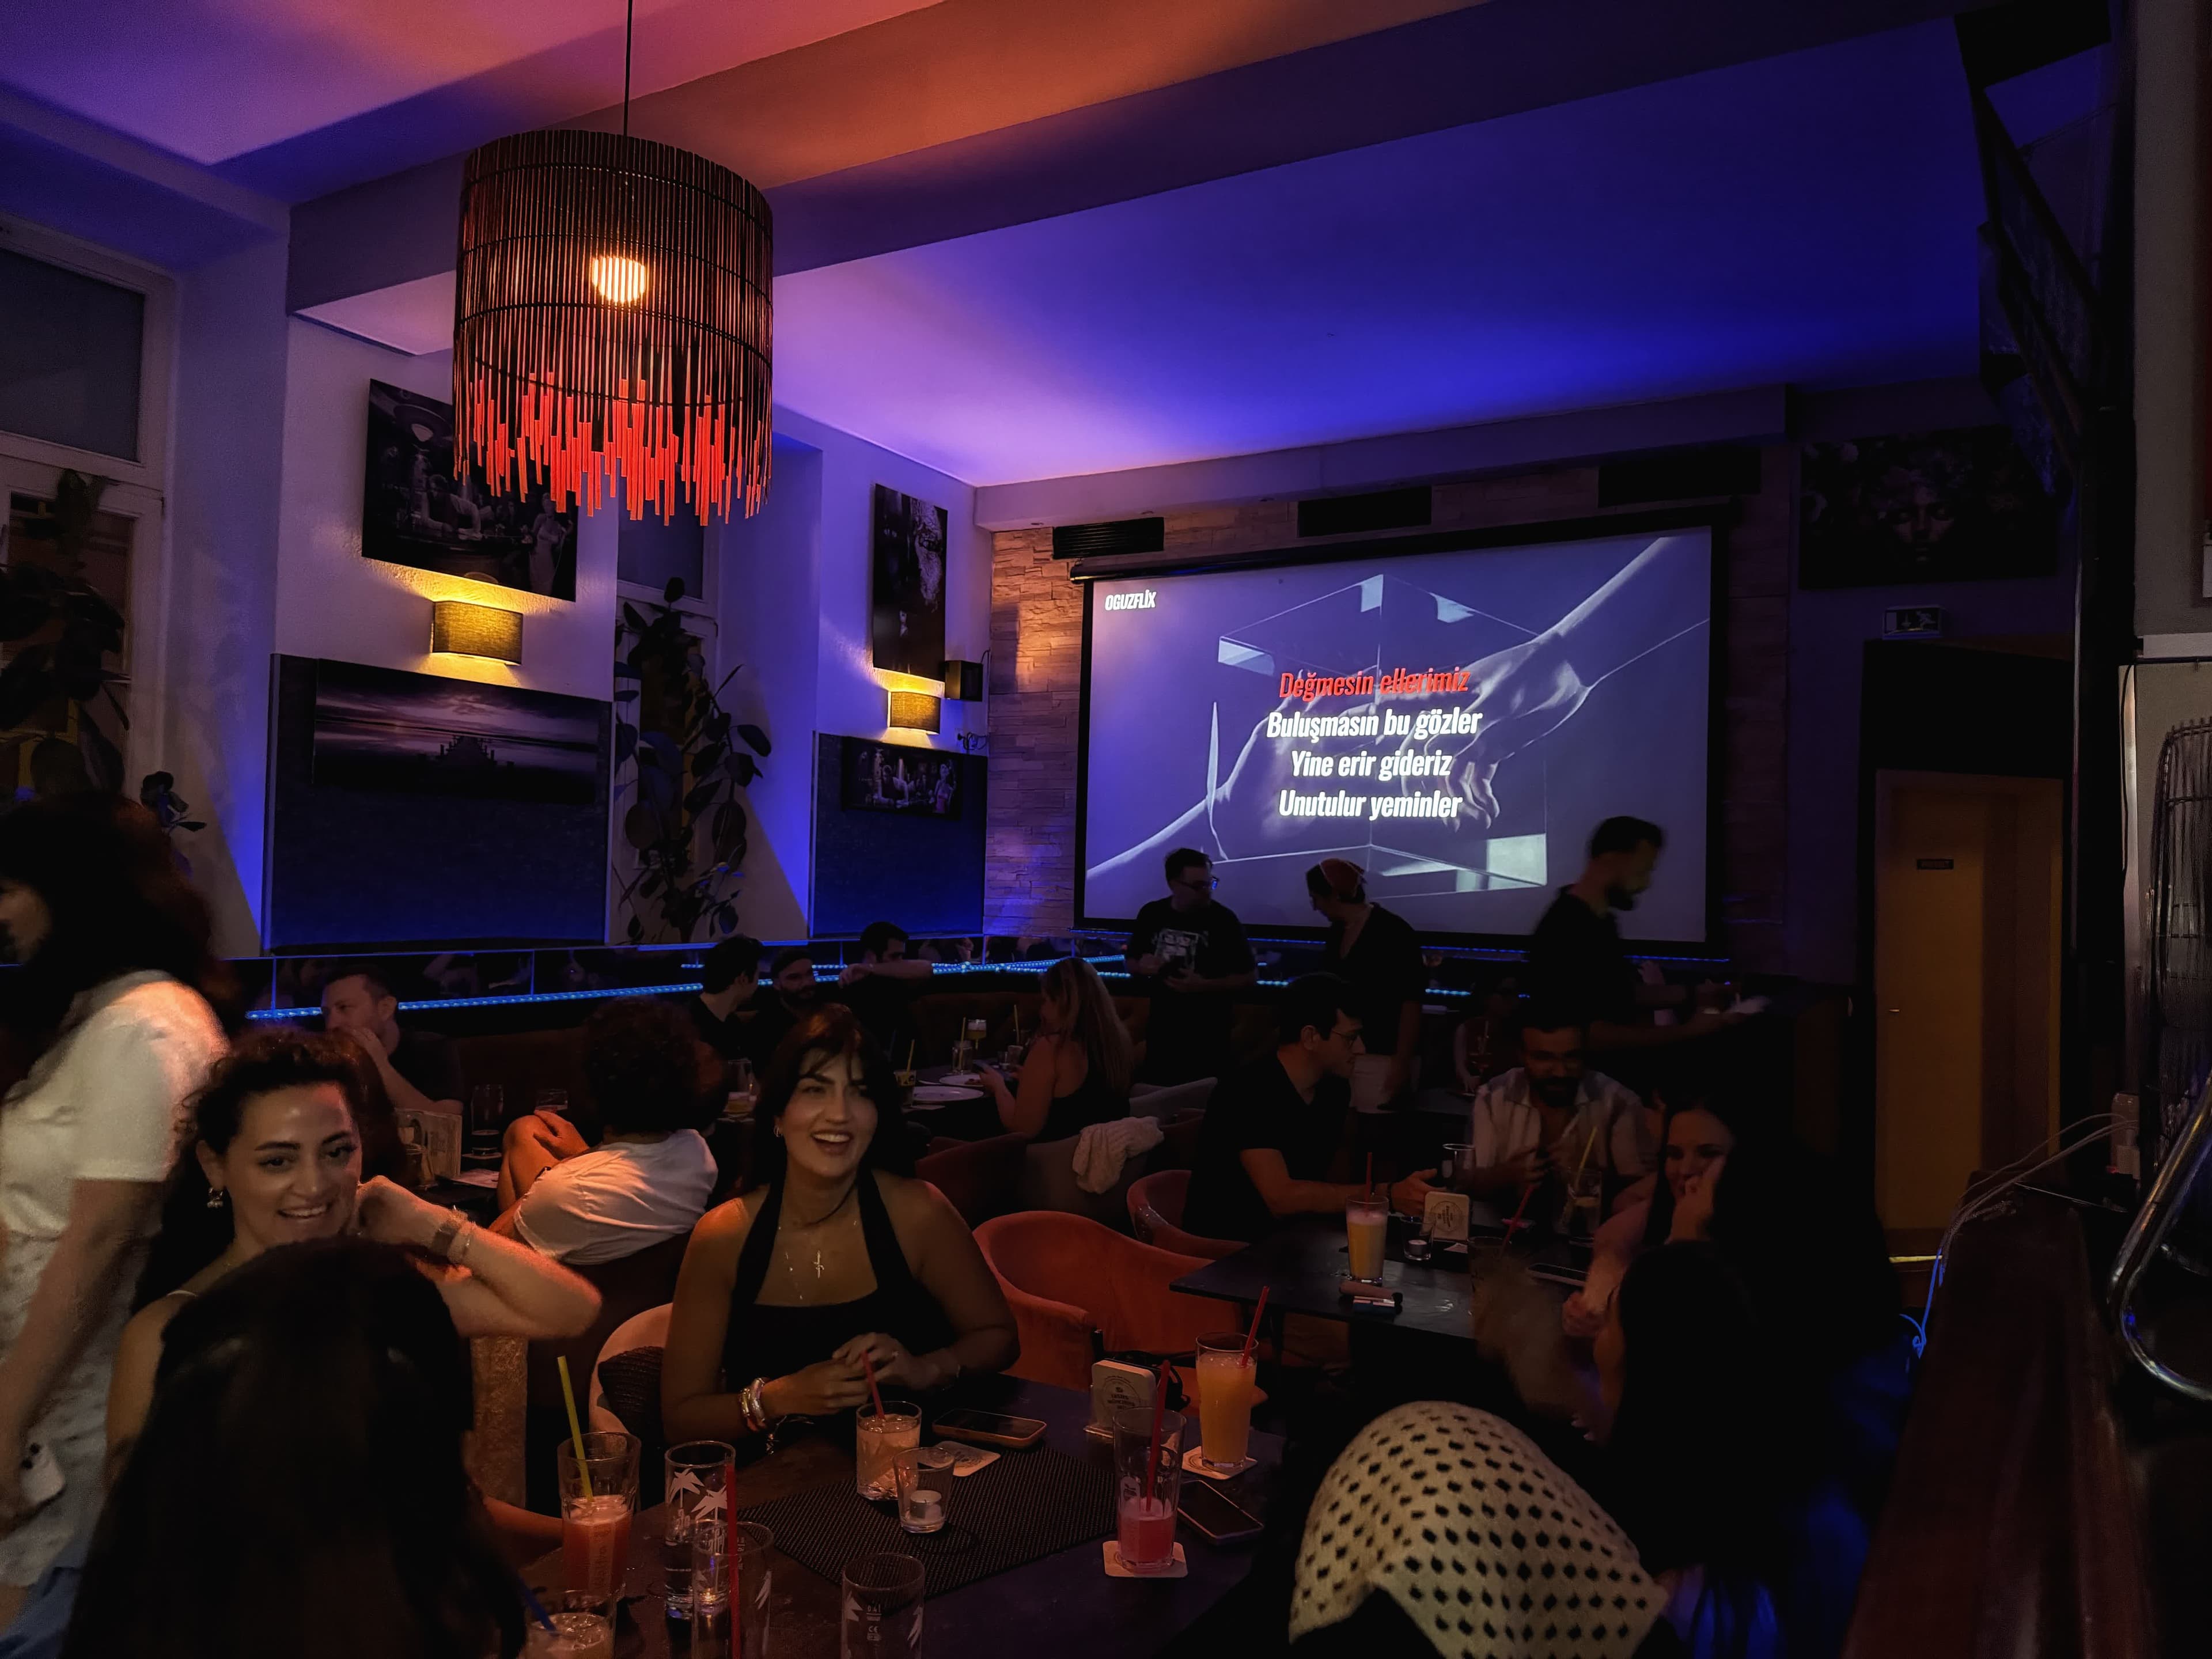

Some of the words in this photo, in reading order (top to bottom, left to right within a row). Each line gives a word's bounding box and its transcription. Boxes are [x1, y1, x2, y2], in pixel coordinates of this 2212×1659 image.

[1279, 671, 1374, 702] Değmesin
[1380, 666, 1471, 695] ellerimiz
[1267, 711, 1380, 744] Buluşmasın
[1384, 709, 1411, 736] bu
[1414, 707, 1483, 740] gözler
[1291, 750, 1334, 777] Yine
[1338, 751, 1377, 777] erir
[1378, 749, 1453, 781] gideriz
[1279, 790, 1366, 816] Unutulur
[1369, 790, 1463, 821] yeminler
